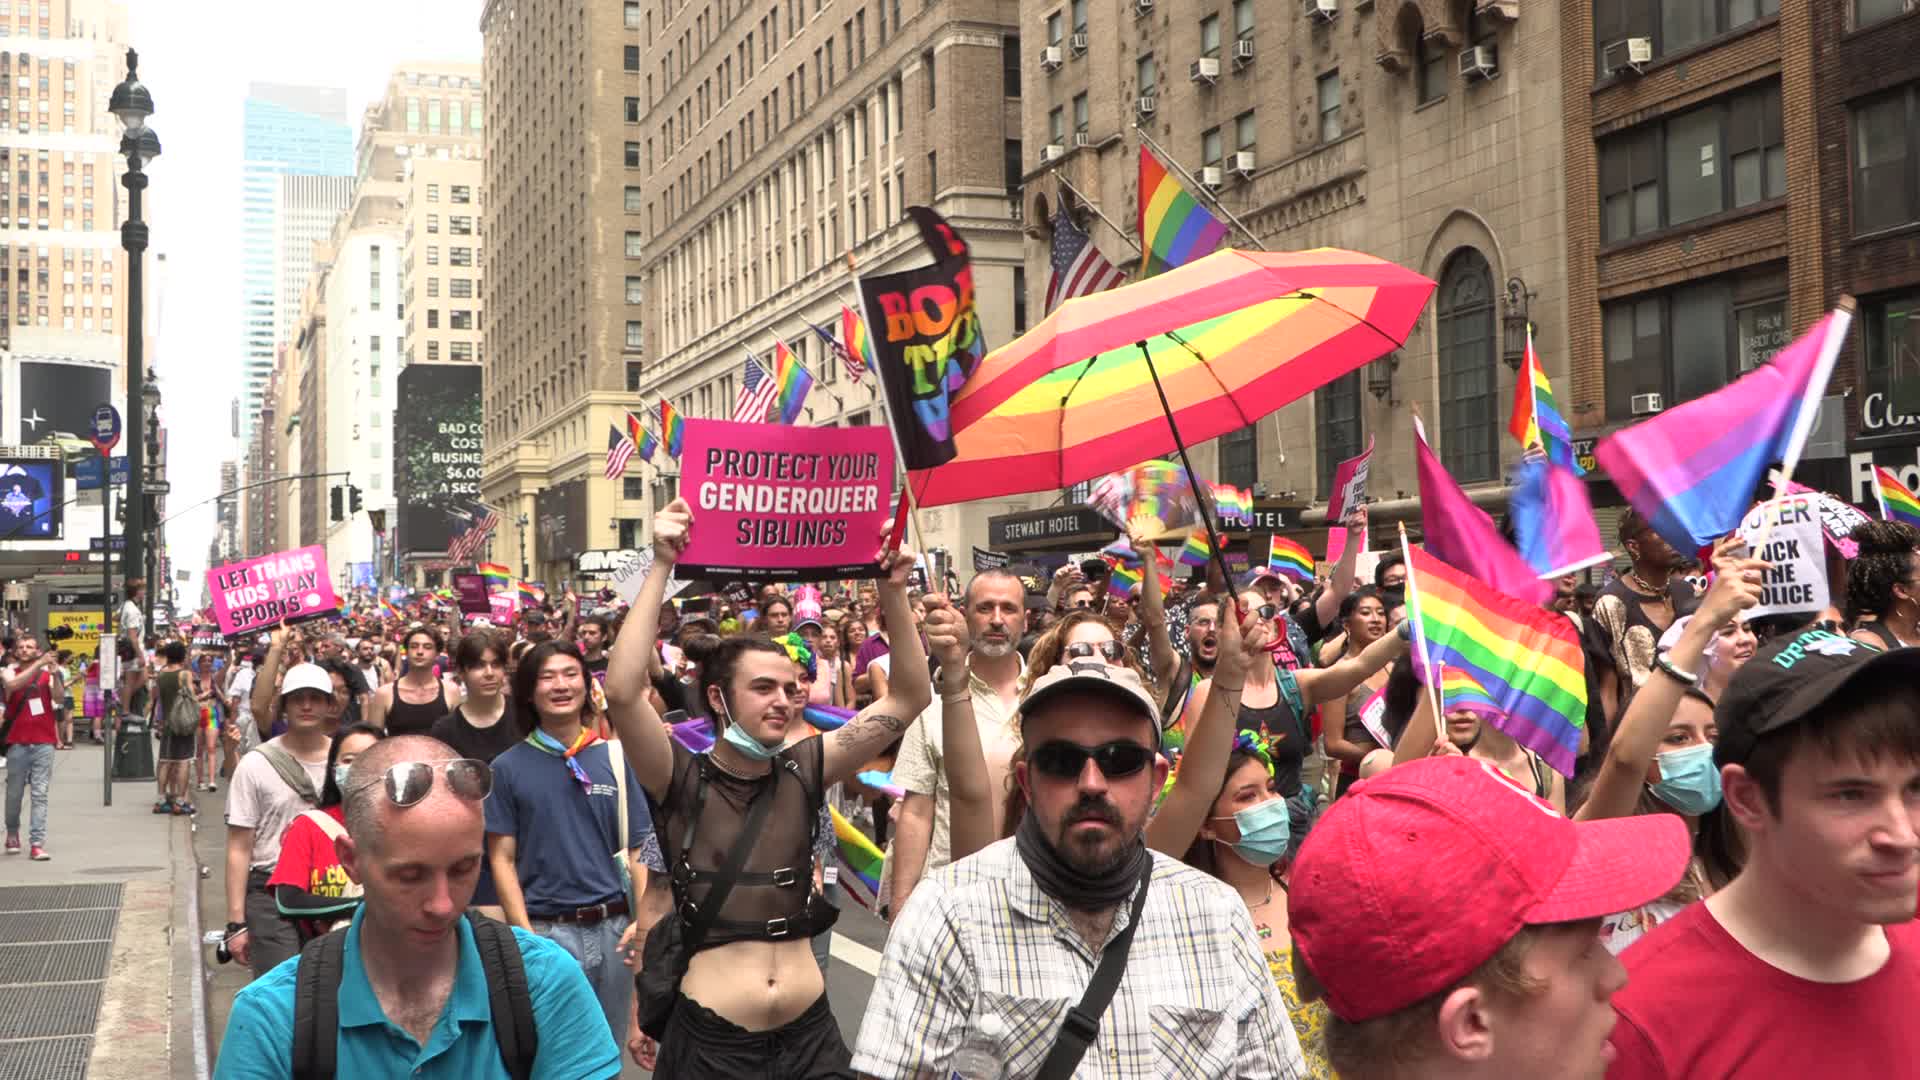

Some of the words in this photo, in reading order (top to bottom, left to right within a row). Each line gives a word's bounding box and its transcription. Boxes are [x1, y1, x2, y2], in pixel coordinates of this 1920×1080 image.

[438, 423, 466, 435] BAD
[706, 448, 822, 482] PROTECT
[828, 452, 879, 481] YOUR
[439, 482, 449, 494] A
[699, 481, 878, 515] GENDERQUEER
[736, 518, 847, 548] SIBLINGS
[1004, 519, 1047, 540] STEWART
[1048, 515, 1080, 535] HOTEL
[218, 568, 250, 591] LET
[252, 553, 316, 582] TRANS
[224, 583, 270, 610] KIDS
[273, 572, 318, 597] PLAY
[1759, 584, 1814, 607] OLICE
[62, 615, 89, 623] WHAT
[231, 596, 303, 628] SPORTS
